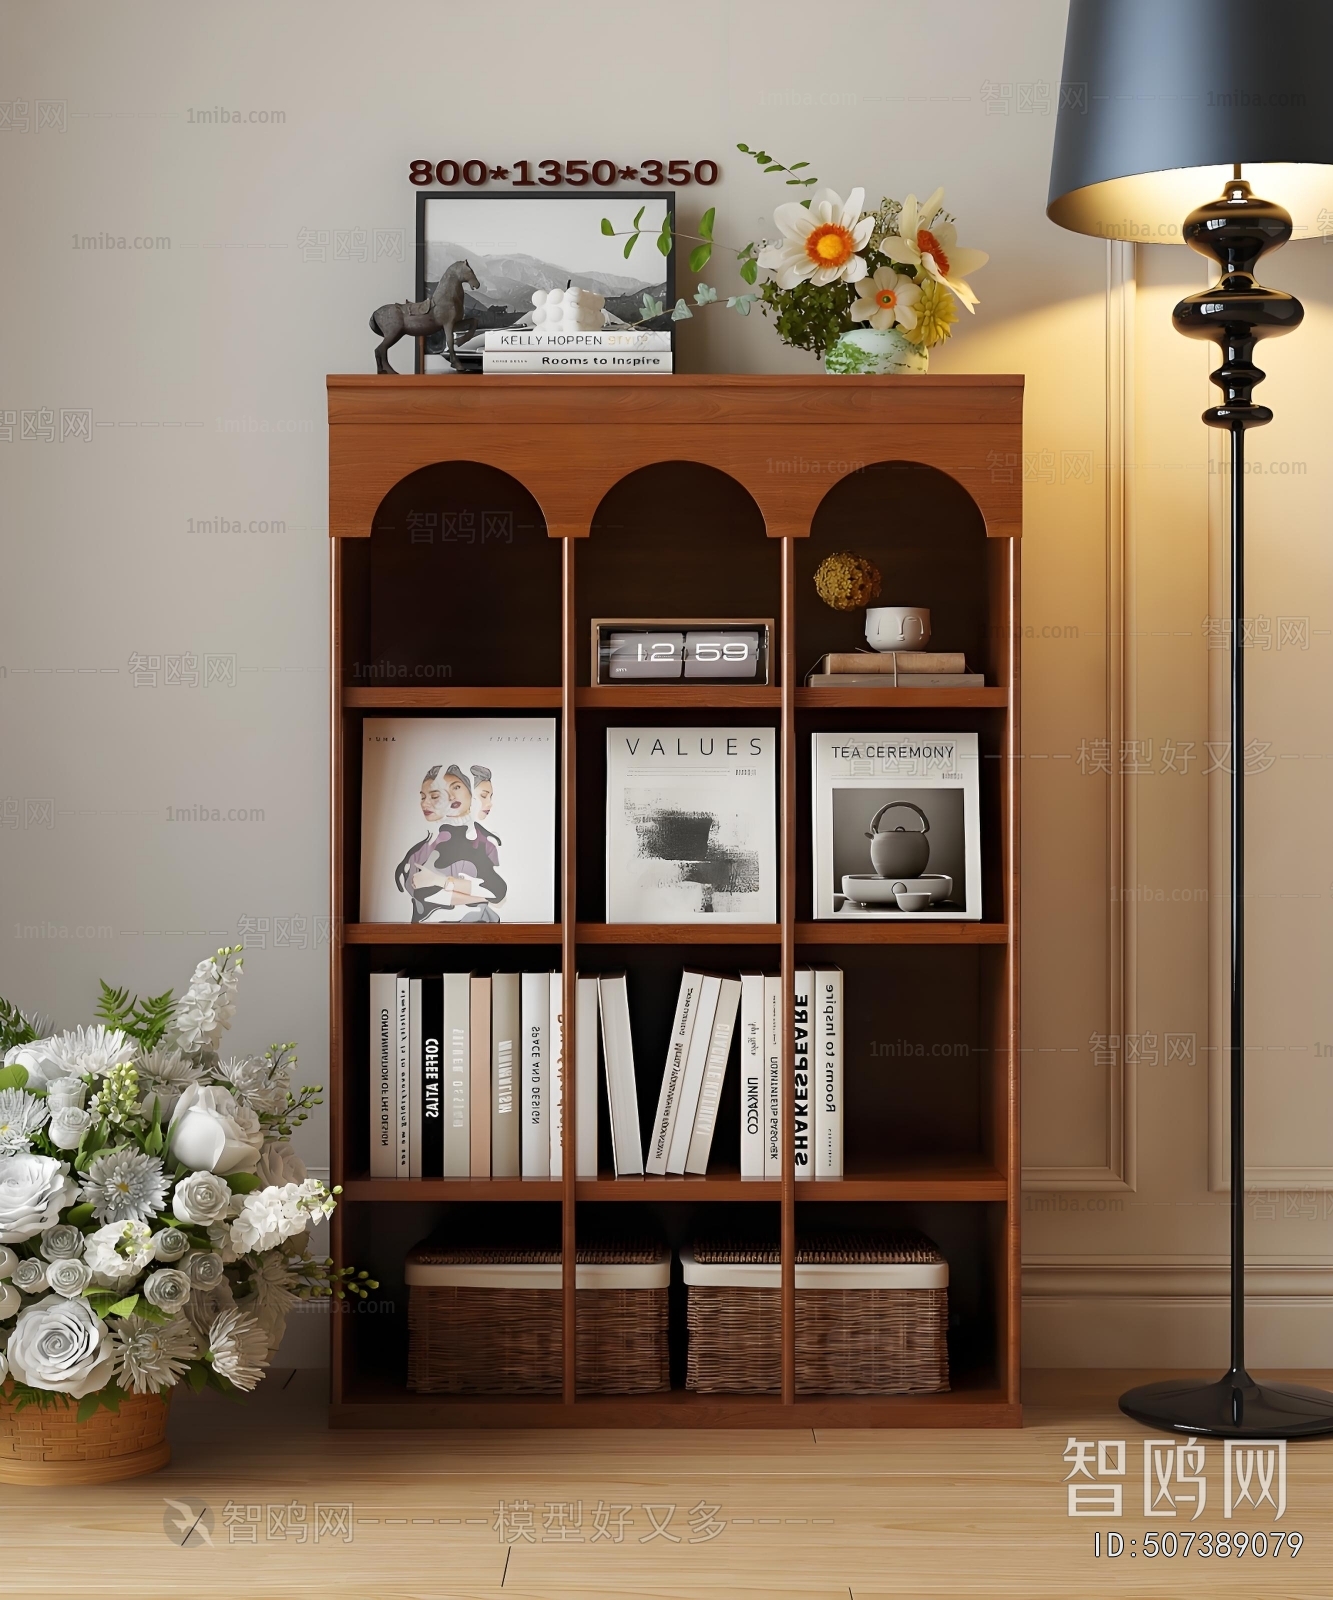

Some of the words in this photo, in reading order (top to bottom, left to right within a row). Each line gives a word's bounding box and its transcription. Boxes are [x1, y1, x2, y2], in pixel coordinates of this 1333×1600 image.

[501, 335, 543, 345] KELLY
[547, 335, 602, 345] HOPPEN
[542, 356, 589, 365] Rooms
[593, 357, 607, 365] to
[612, 356, 660, 367] Inspire
[637, 643, 675, 662] 12
[695, 642, 749, 662] 59
[625, 738, 762, 756] VALUES
[831, 746, 862, 758] TEA
[866, 746, 954, 758] CEREMONY
